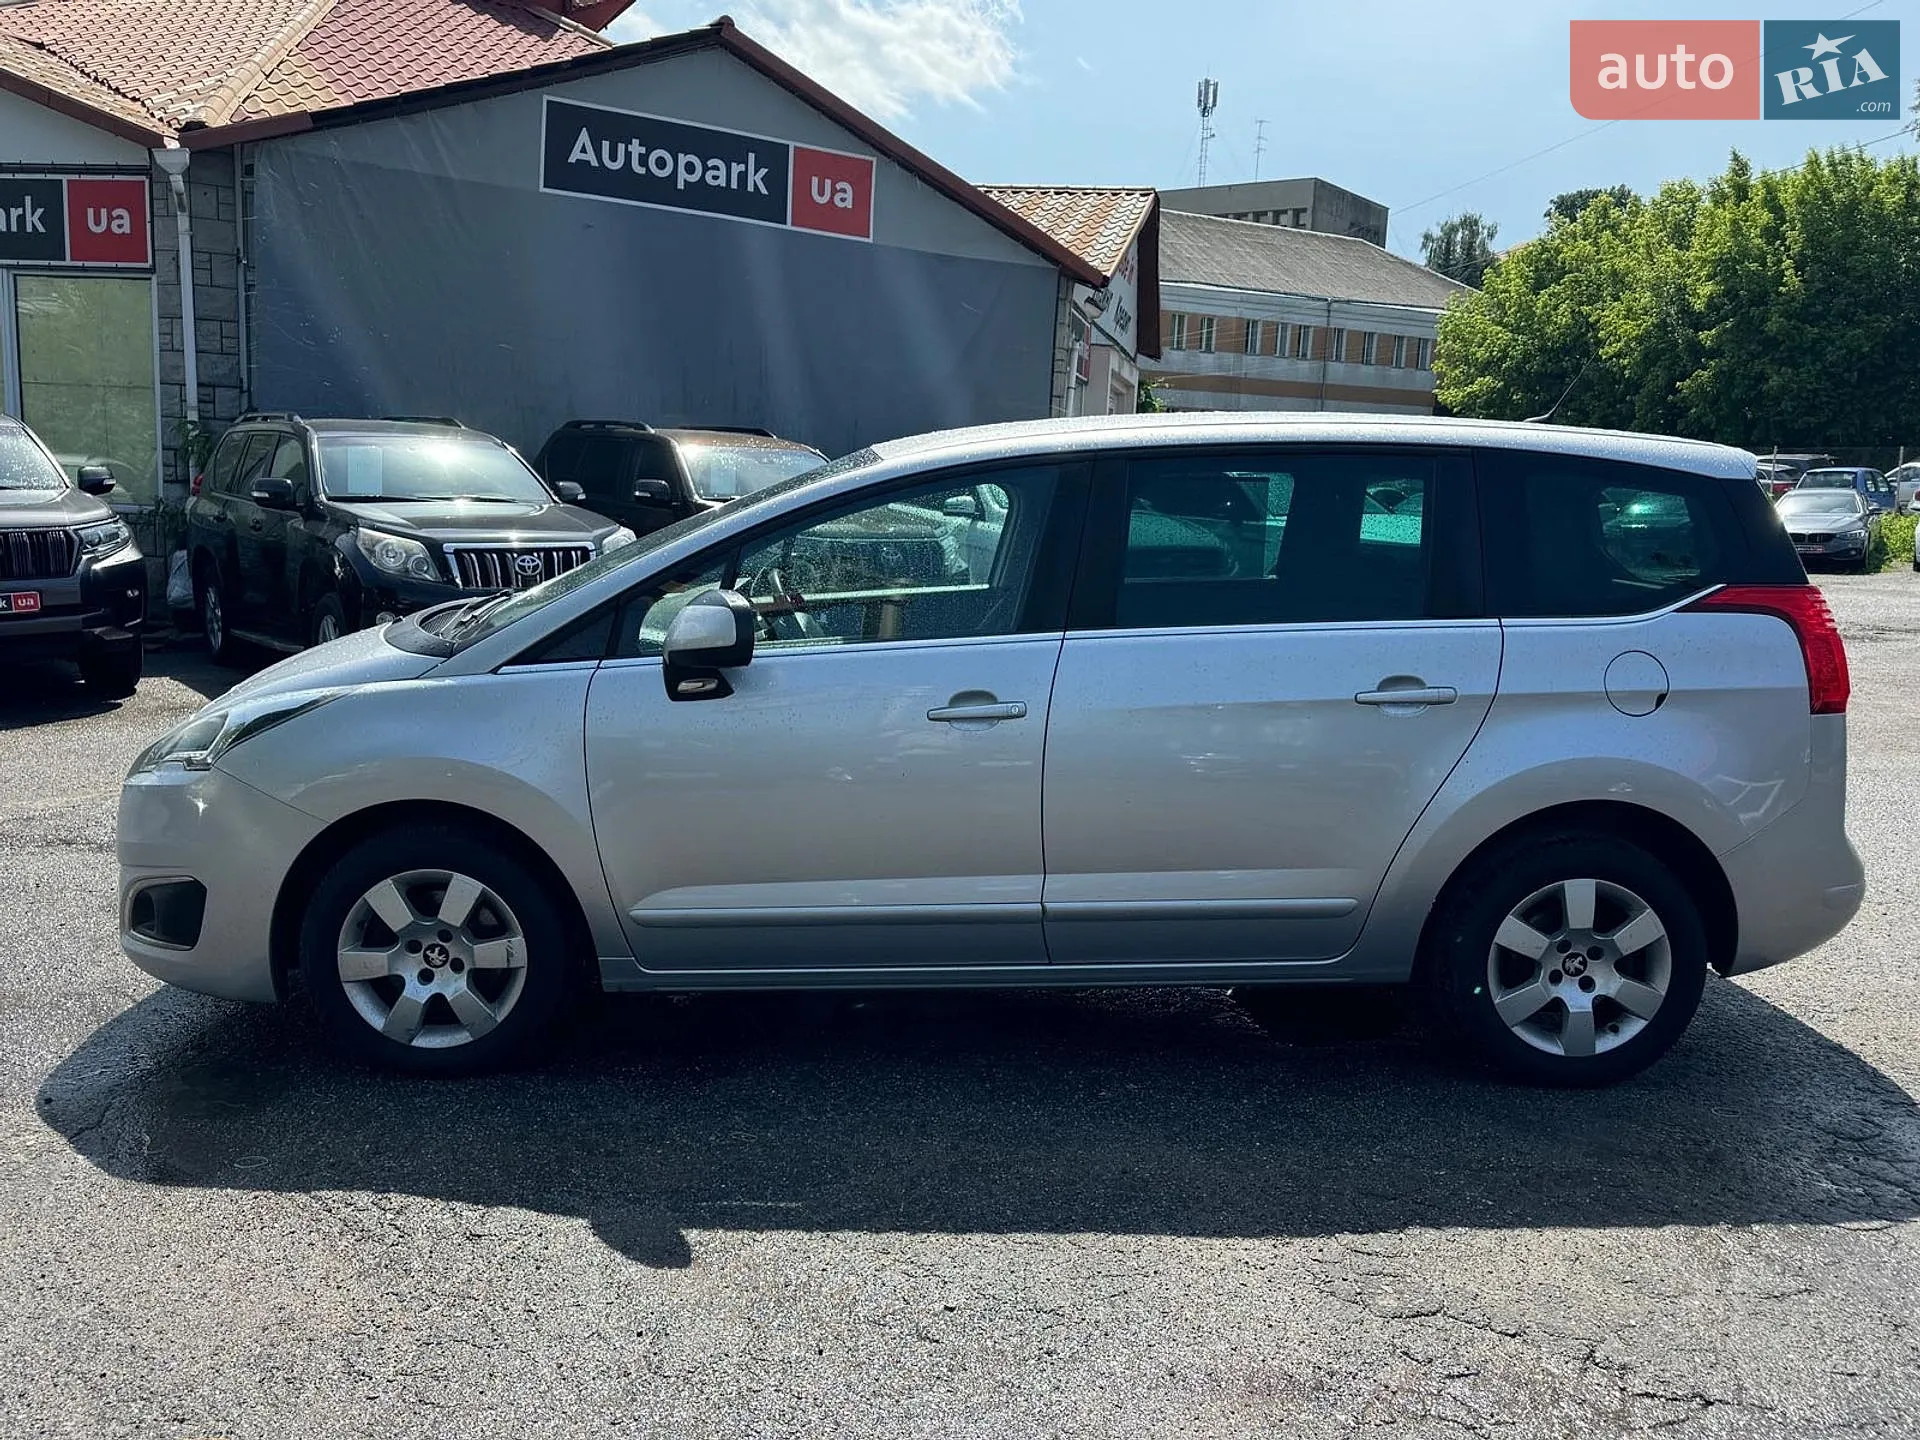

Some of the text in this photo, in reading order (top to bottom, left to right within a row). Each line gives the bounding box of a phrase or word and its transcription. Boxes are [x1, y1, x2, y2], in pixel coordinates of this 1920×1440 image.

[567, 127, 853, 209] Autopark ua
[86, 207, 131, 234] ua
[18, 598, 34, 606] ua
